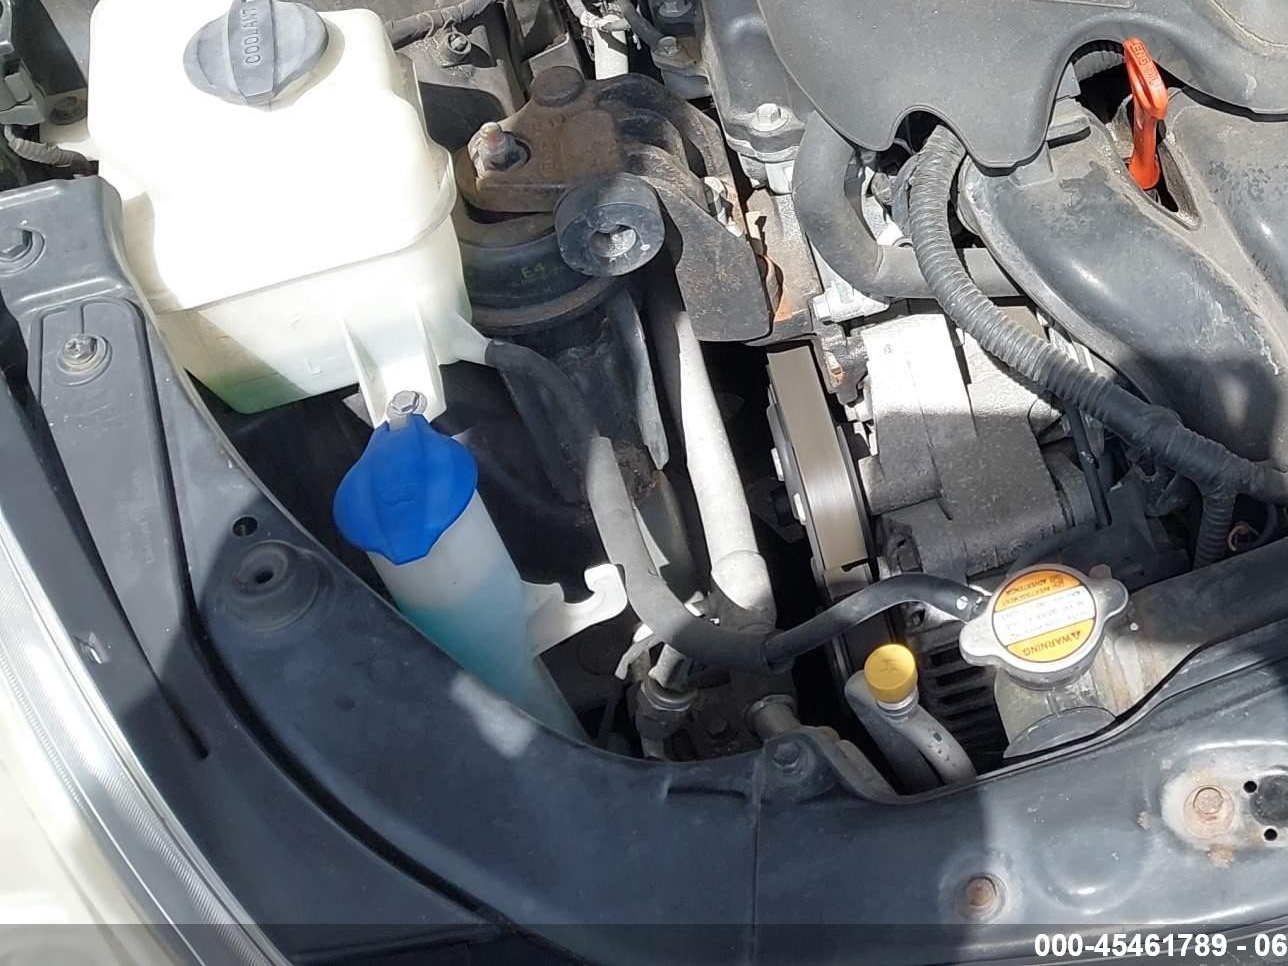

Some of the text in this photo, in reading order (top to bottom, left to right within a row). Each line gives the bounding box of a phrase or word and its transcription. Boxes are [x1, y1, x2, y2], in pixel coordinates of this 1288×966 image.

[241, 8, 261, 65] COOLANT
[1132, 41, 1151, 66] ENG
[1022, 634, 1072, 656] WARNING
